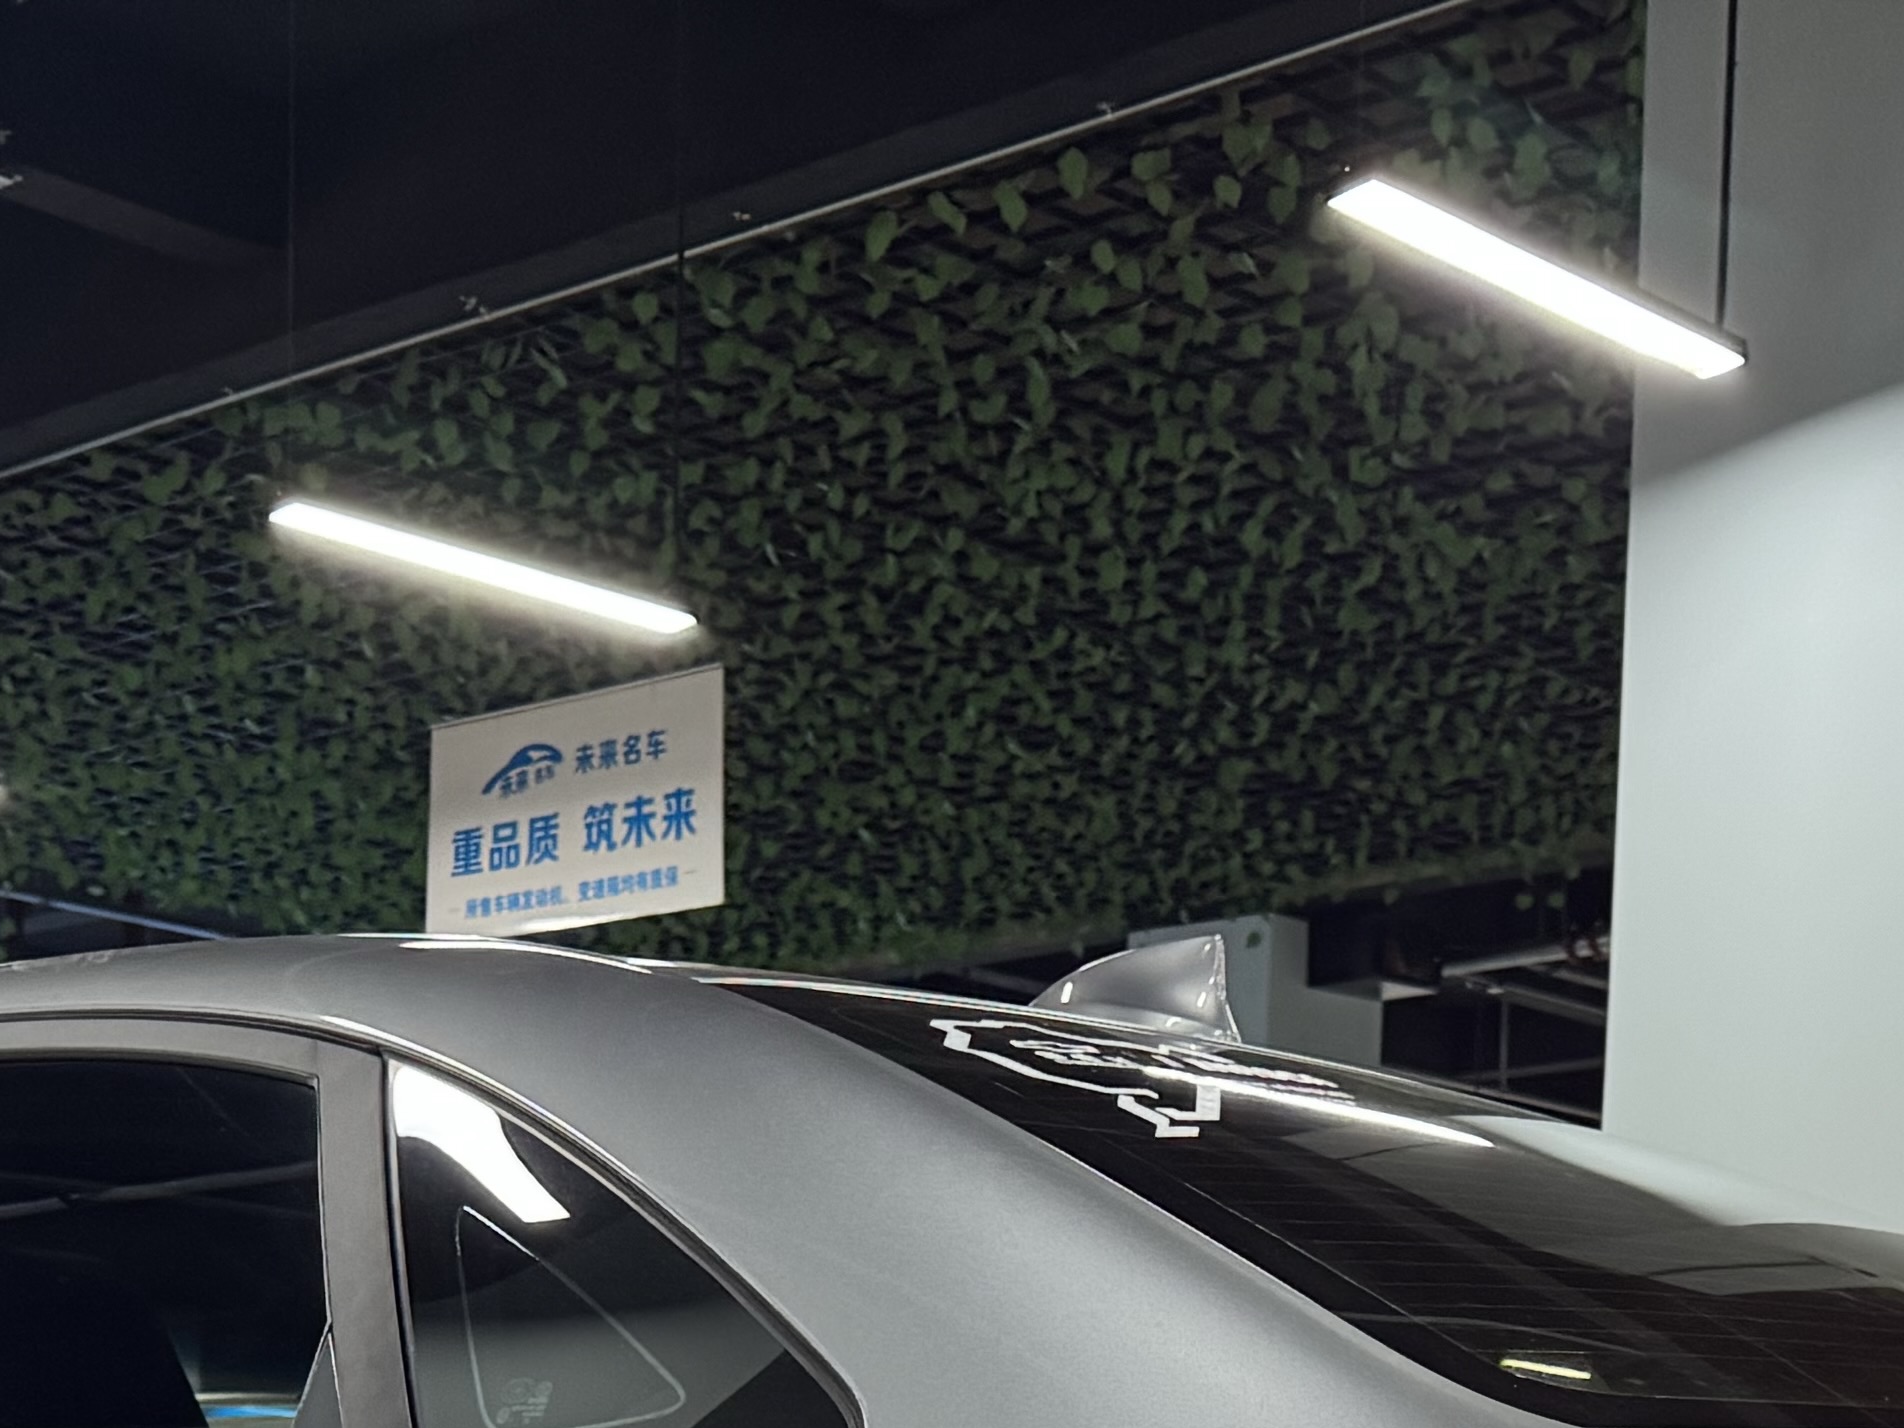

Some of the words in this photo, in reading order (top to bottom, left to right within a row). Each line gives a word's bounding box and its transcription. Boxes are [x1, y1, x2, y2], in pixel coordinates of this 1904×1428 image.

[574, 730, 668, 775] 未来名车
[451, 812, 561, 878] 重品质
[583, 787, 697, 854] 筑未来
